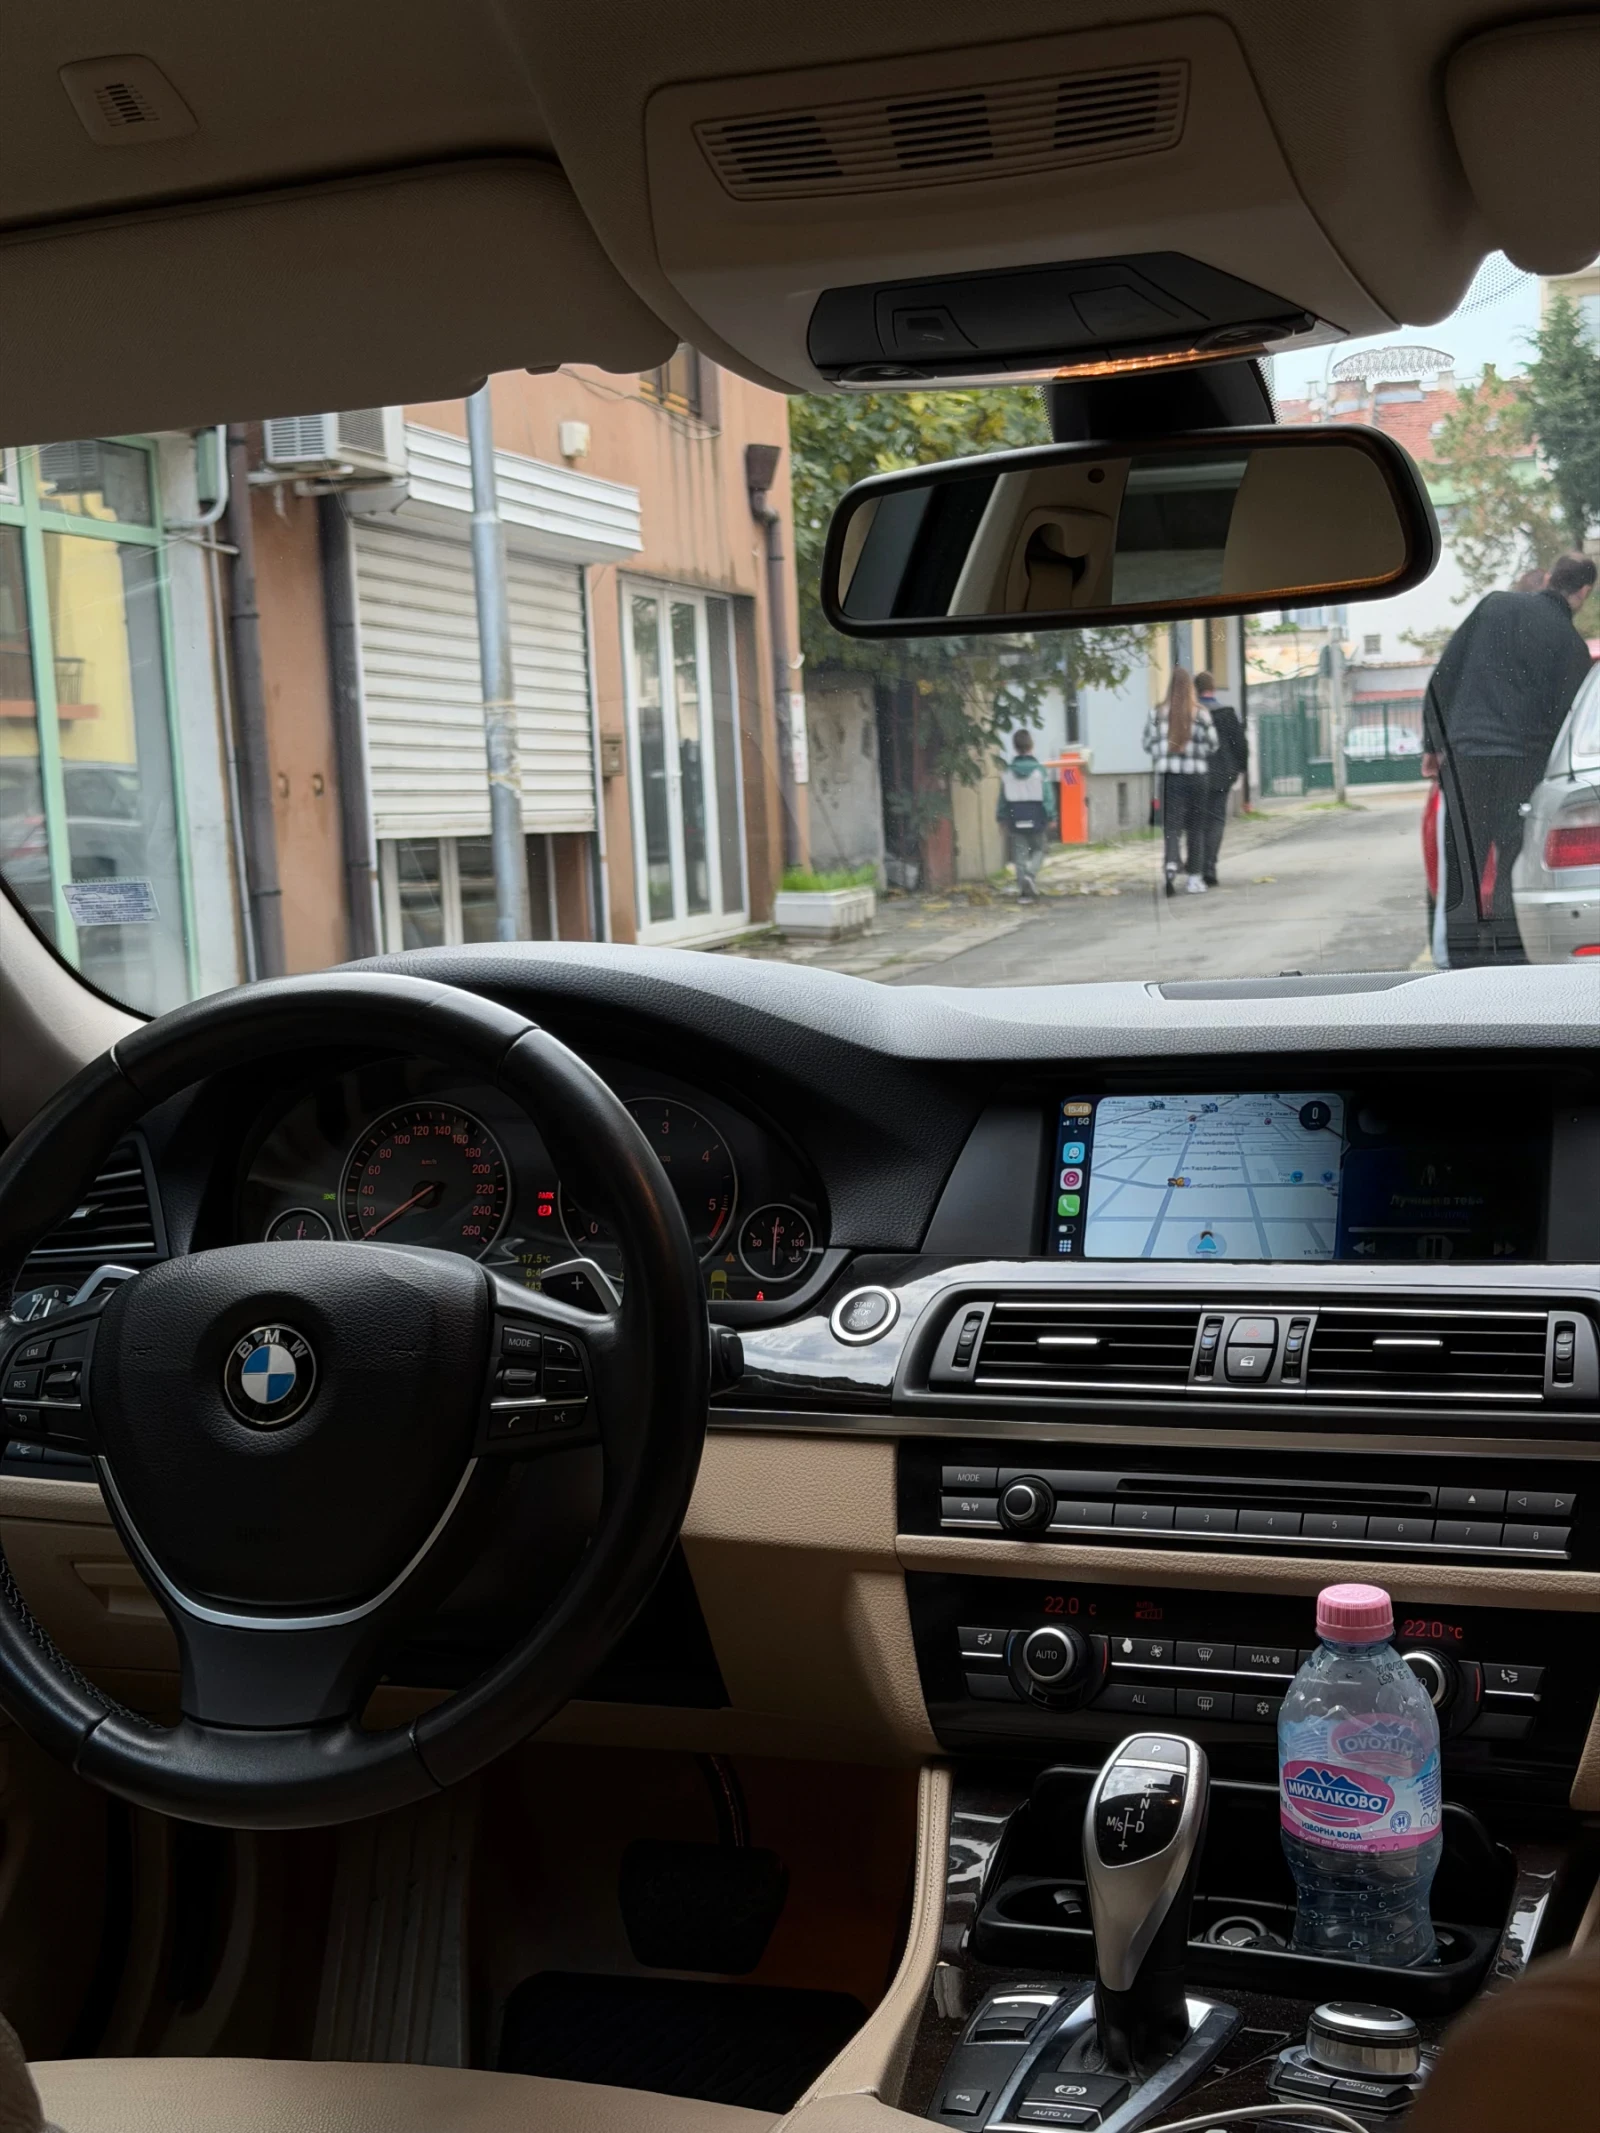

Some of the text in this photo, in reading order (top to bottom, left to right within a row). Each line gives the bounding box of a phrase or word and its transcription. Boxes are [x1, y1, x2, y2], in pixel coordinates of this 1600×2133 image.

[1312, 1107, 1319, 1119] 0
[412, 1126, 429, 1136] 120
[433, 1126, 451, 1136] 140
[661, 1121, 670, 1134] 3
[393, 1135, 411, 1145] 100
[452, 1135, 469, 1144] 160
[379, 1149, 392, 1159] 80
[464, 1148, 481, 1158] 180
[702, 1150, 711, 1163] 4
[368, 1165, 381, 1175] 60
[472, 1164, 490, 1174] 200
[362, 1185, 375, 1195] 40
[476, 1184, 494, 1194] 220
[708, 1198, 717, 1211] 5
[362, 1207, 375, 1216] 20
[472, 1206, 491, 1216] 240
[462, 1225, 481, 1236] 260
[589, 1221, 599, 1234] 0
[752, 1239, 763, 1247] 50
[790, 1239, 805, 1247] 150
[236, 1329, 309, 1359] BMW
[508, 1338, 532, 1347] MODE
[13, 1380, 27, 1388] RES
[957, 1473, 980, 1482] MODE
[1142, 1511, 1148, 1519] 2
[1204, 1514, 1210, 1523] 3
[1267, 1517, 1273, 1526] 4
[1332, 1520, 1338, 1529] 5
[1398, 1524, 1404, 1533] 6
[1465, 1527, 1471, 1536] 7
[1533, 1531, 1539, 1541] 8
[1044, 1596, 1080, 1614] 22.0
[1403, 1620, 1443, 1638] 22.0
[1036, 1650, 1058, 1660] AUTO
[1251, 1655, 1271, 1664] MAX
[1132, 1694, 1147, 1704] ALL
[1152, 1745, 1161, 1754] P
[1288, 1781, 1383, 1811] МИХАЛКОВО
[1140, 1798, 1151, 1809] N
[1135, 1820, 1145, 1833] D
[1301, 1821, 1363, 1841] ИЗВОРНА ВОДА
[1294, 2071, 1320, 2081] BACK
[1345, 2082, 1384, 2093] OPTION
[1032, 2109, 1061, 2117] AUTO
